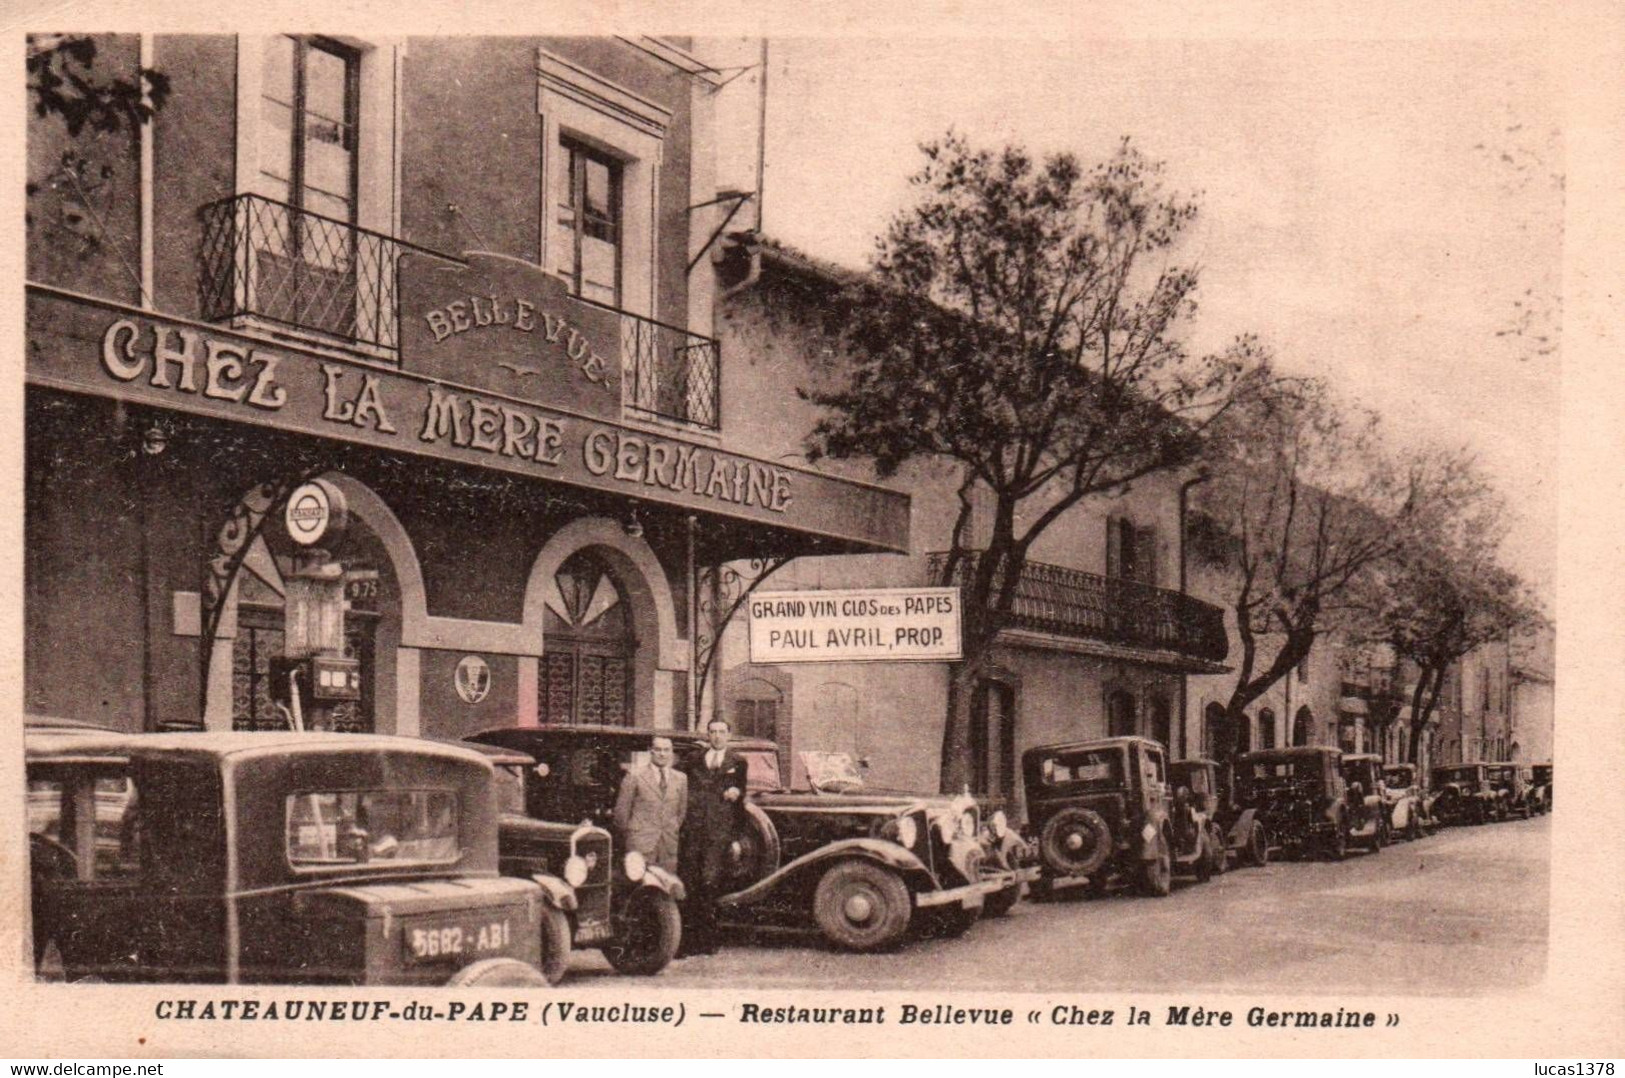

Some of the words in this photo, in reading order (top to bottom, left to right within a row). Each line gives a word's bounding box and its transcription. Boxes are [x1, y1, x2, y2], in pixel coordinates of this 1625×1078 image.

[102, 319, 288, 412] CHEZ
[321, 364, 397, 435] LA
[419, 383, 567, 466] MERE
[582, 429, 795, 513] GERMAINE
[752, 601, 806, 619] GRAND
[809, 601, 838, 618] VIN
[842, 599, 878, 617] CLOS
[905, 597, 953, 615] PAPES
[770, 630, 818, 648] PAUL
